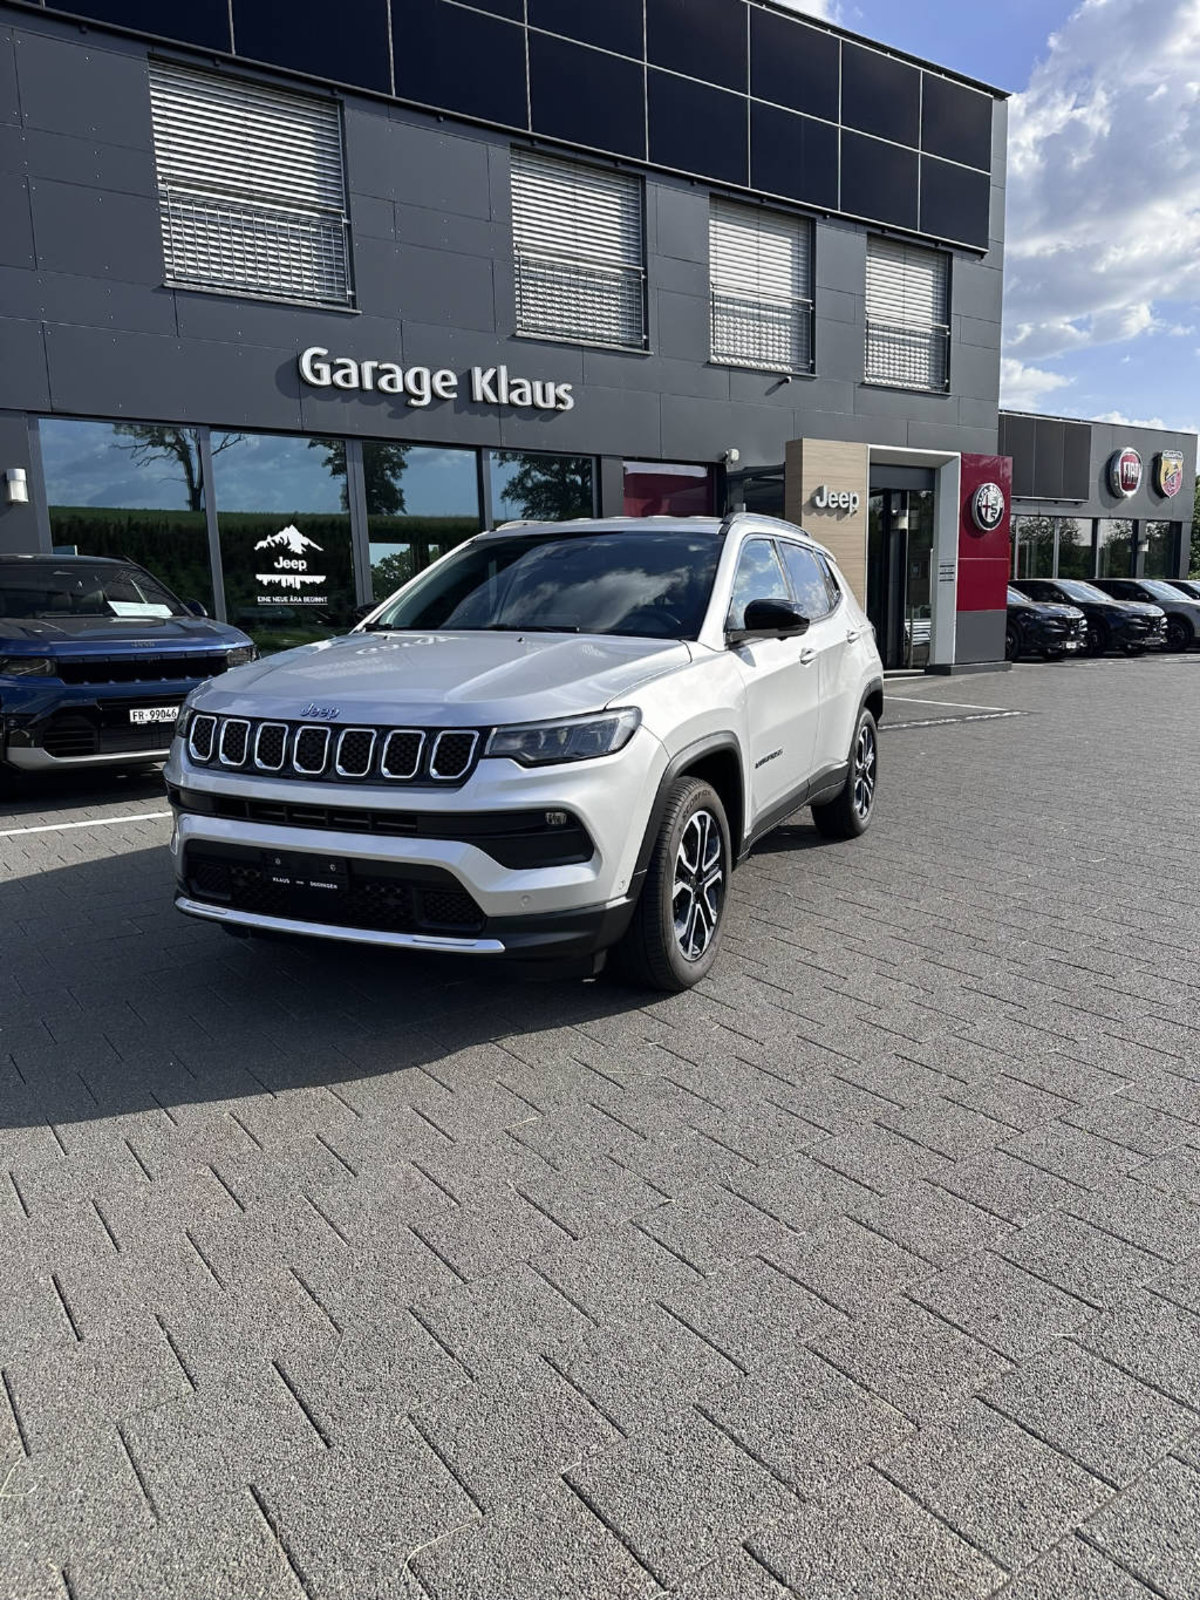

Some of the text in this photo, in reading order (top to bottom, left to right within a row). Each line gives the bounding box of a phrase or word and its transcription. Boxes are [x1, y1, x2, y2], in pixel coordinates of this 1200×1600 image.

[299, 346, 575, 410] Garage Klaus
[814, 485, 860, 513] Jeep
[274, 556, 307, 571] Jeep
[300, 703, 340, 721] Jeep
